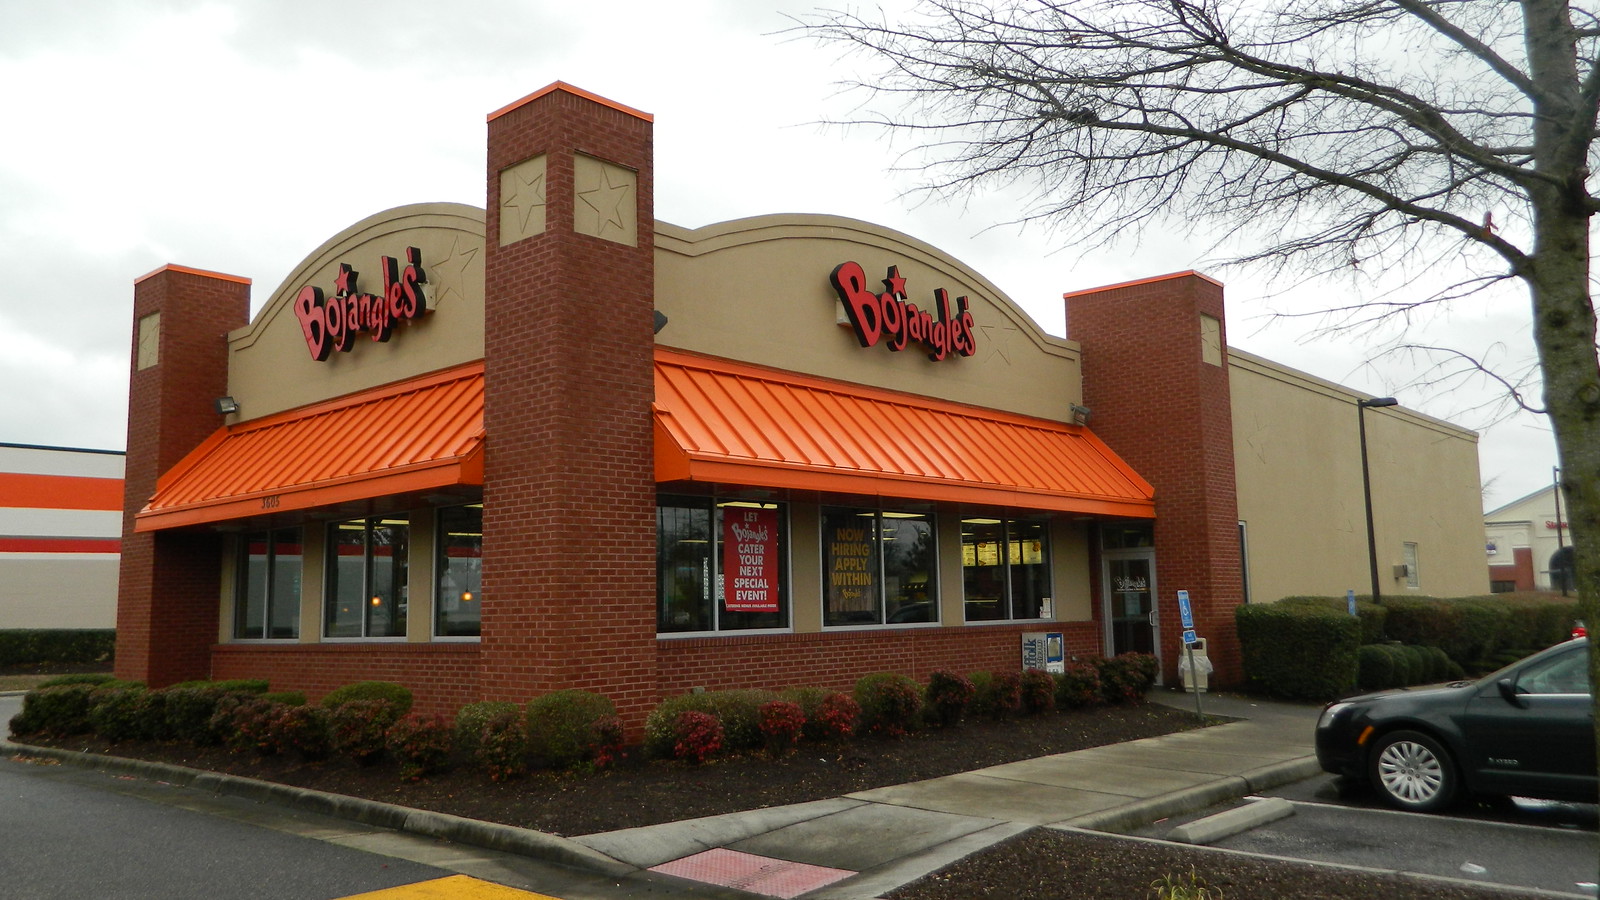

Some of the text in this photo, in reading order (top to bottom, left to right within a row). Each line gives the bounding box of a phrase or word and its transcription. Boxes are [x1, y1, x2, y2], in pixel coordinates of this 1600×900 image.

[744, 512, 758, 521] LET
[837, 528, 864, 541] NOW
[738, 544, 765, 554] CATER
[832, 543, 869, 556] HIRING
[739, 555, 764, 565] YOUR
[835, 558, 868, 571] APPLY
[740, 566, 764, 576] NEXT
[734, 578, 769, 589] SPECIAL
[832, 572, 872, 586] WITHIN
[736, 590, 768, 601] EVENT!
